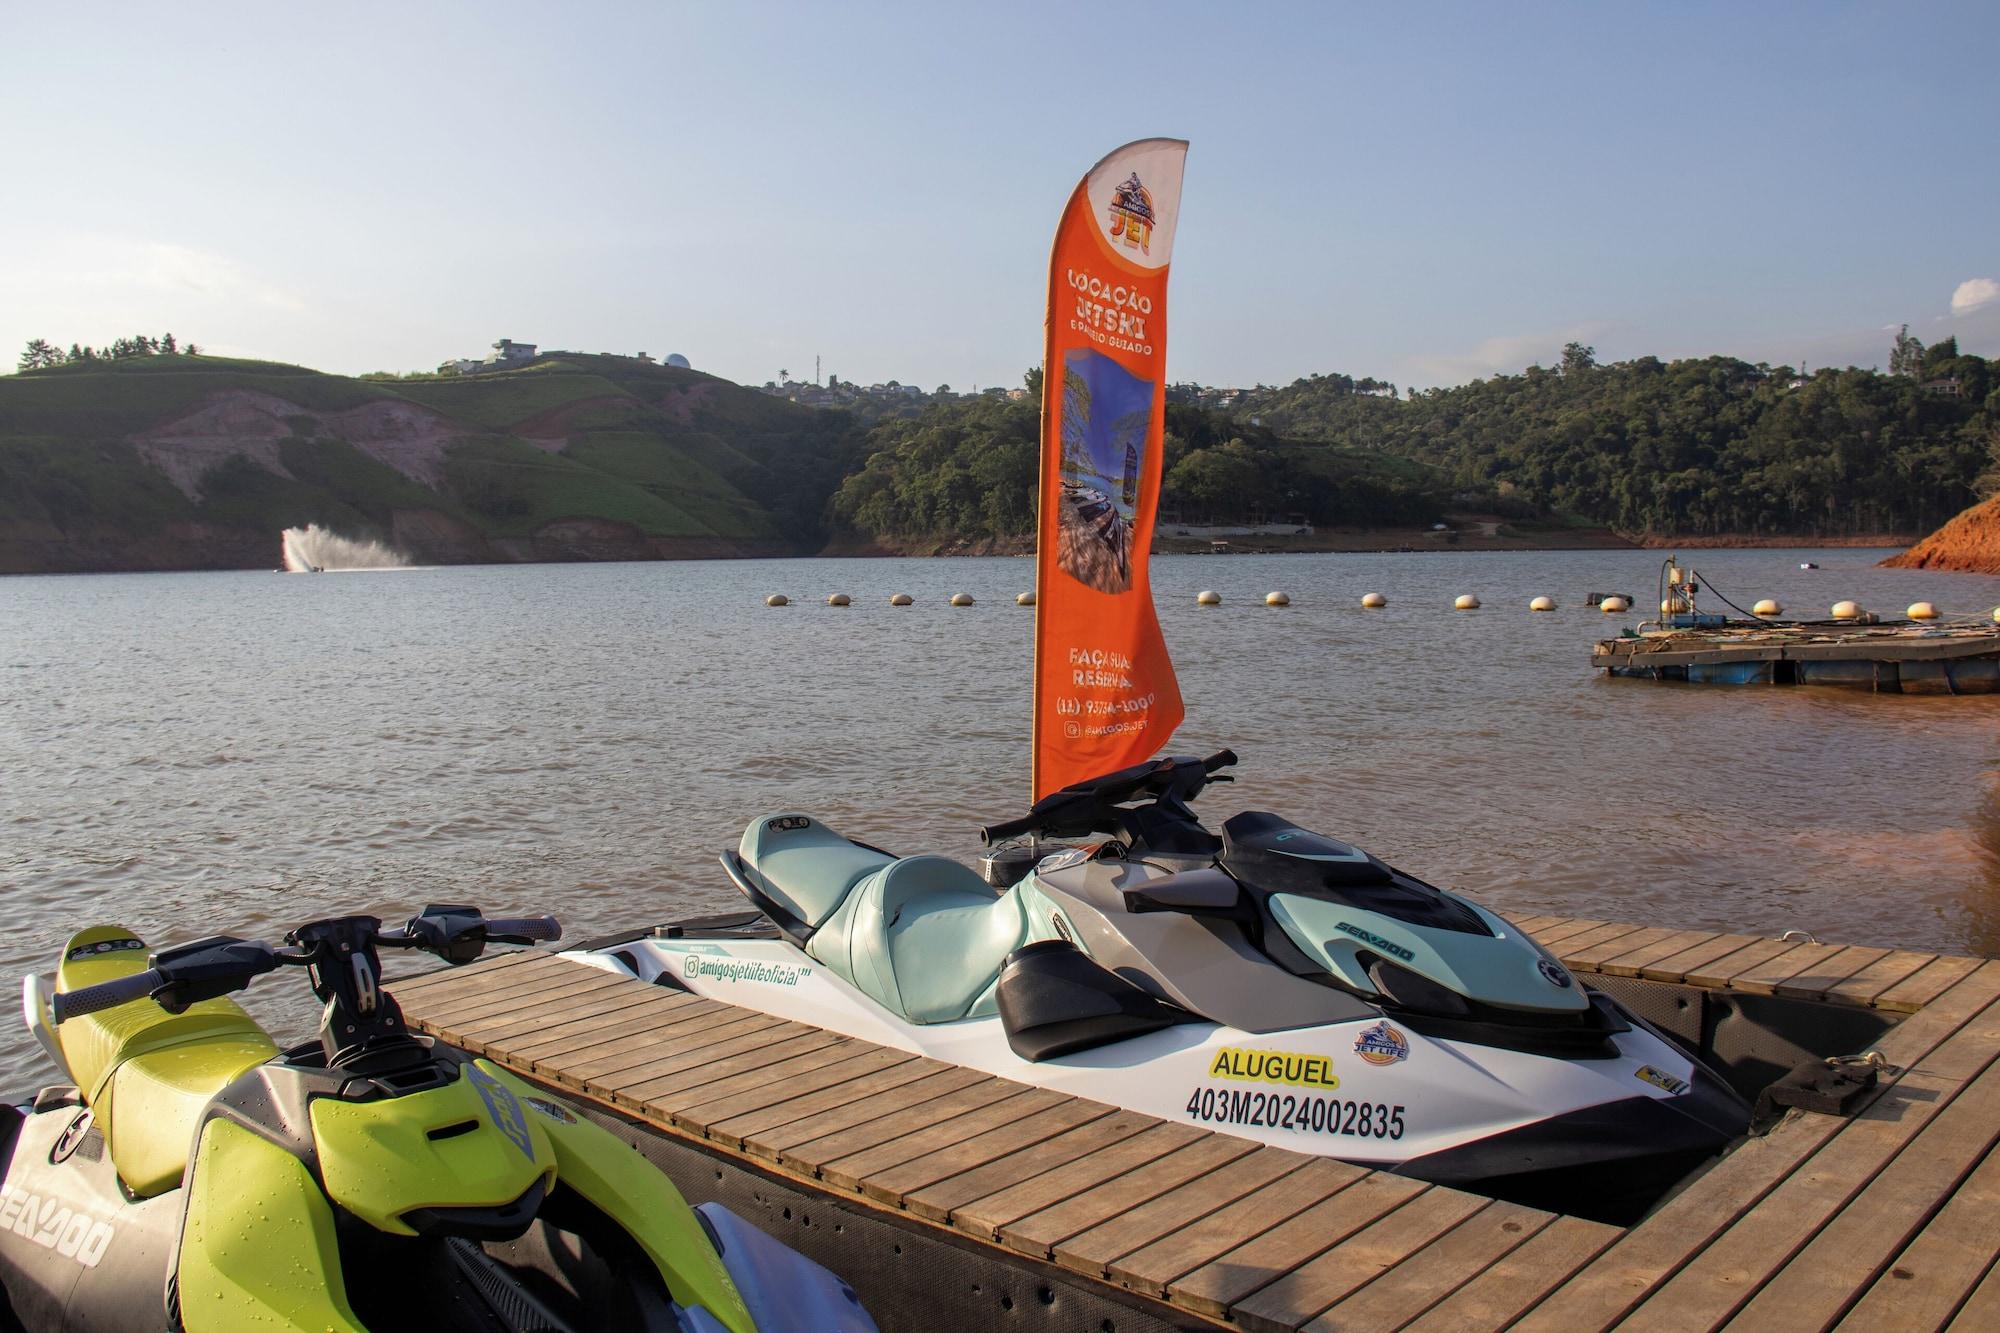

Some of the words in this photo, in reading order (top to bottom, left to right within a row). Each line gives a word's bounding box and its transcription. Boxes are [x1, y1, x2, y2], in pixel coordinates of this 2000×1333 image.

[1067, 268, 1153, 315] LOCAÇÃO
[1108, 335, 1153, 356] GUIADO
[1069, 647, 1109, 670] FAÇA
[1109, 651, 1131, 670] SUA
[1056, 696, 1081, 716] (11)
[1354, 1044, 1376, 1053] JET
[1378, 1047, 1405, 1059] LIFE
[1213, 1051, 1335, 1086] ALUGUEL
[1185, 1086, 1406, 1141] 403M2024002835
[0, 1187, 116, 1268] EADOO
